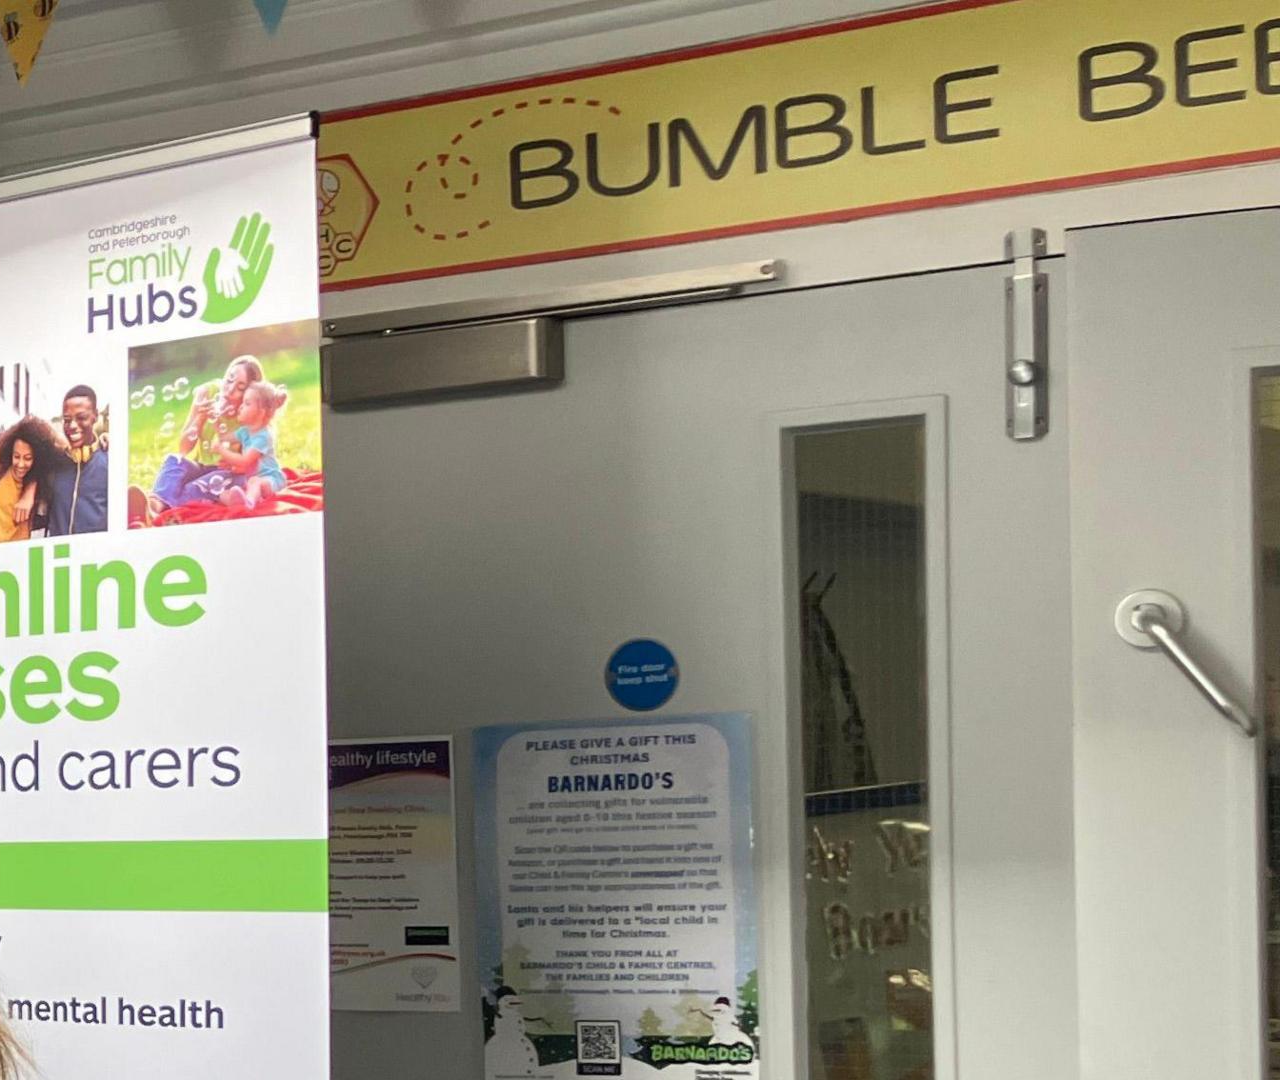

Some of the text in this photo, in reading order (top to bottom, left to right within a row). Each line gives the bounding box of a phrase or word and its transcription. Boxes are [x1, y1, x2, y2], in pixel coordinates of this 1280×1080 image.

[508, 65, 1001, 211] BUMBLE
[89, 213, 177, 240] Cambridgeshire
[89, 224, 191, 254] and Peterborough
[88, 242, 192, 290] Family
[87, 281, 198, 334] Hubs
[526, 734, 697, 751] PLEASE GIVE A GIFT THIS
[58, 743, 241, 793] carers
[330, 748, 438, 769] ealthy lifestyle
[570, 752, 650, 765] CHRISTMAS
[548, 771, 674, 793] BARNARDO'S
[7, 996, 225, 1030] mental health
[651, 1043, 753, 1062] BARNARDO'S
